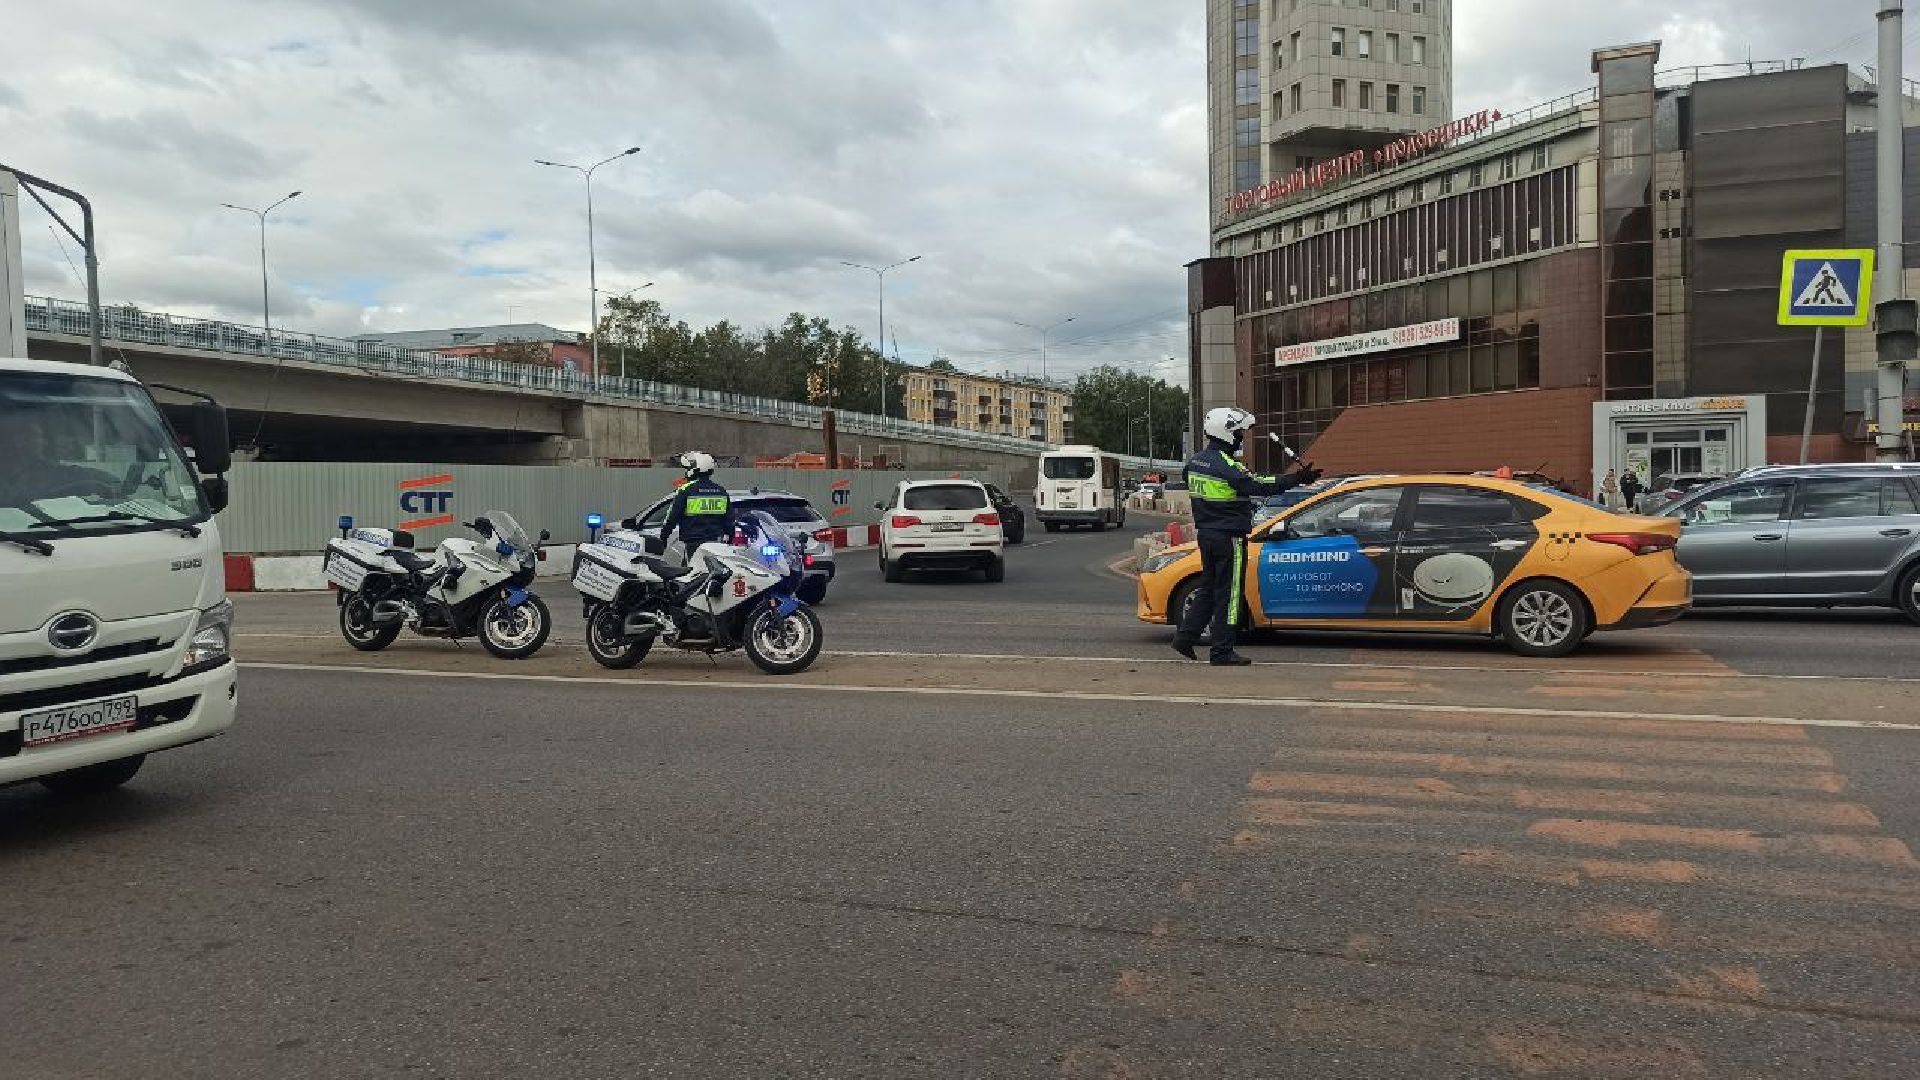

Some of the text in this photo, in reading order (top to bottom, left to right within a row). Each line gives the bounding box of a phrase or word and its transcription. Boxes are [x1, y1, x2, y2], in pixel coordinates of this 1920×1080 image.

[1226, 167, 1305, 214] ТОРГОВЫЙ
[1310, 149, 1364, 187] ЦЕНТР
[400, 491, 453, 513] СТГ
[1268, 551, 1350, 563] REDMOND
[1268, 572, 1333, 582] ЕСЛИ РОБОТ
